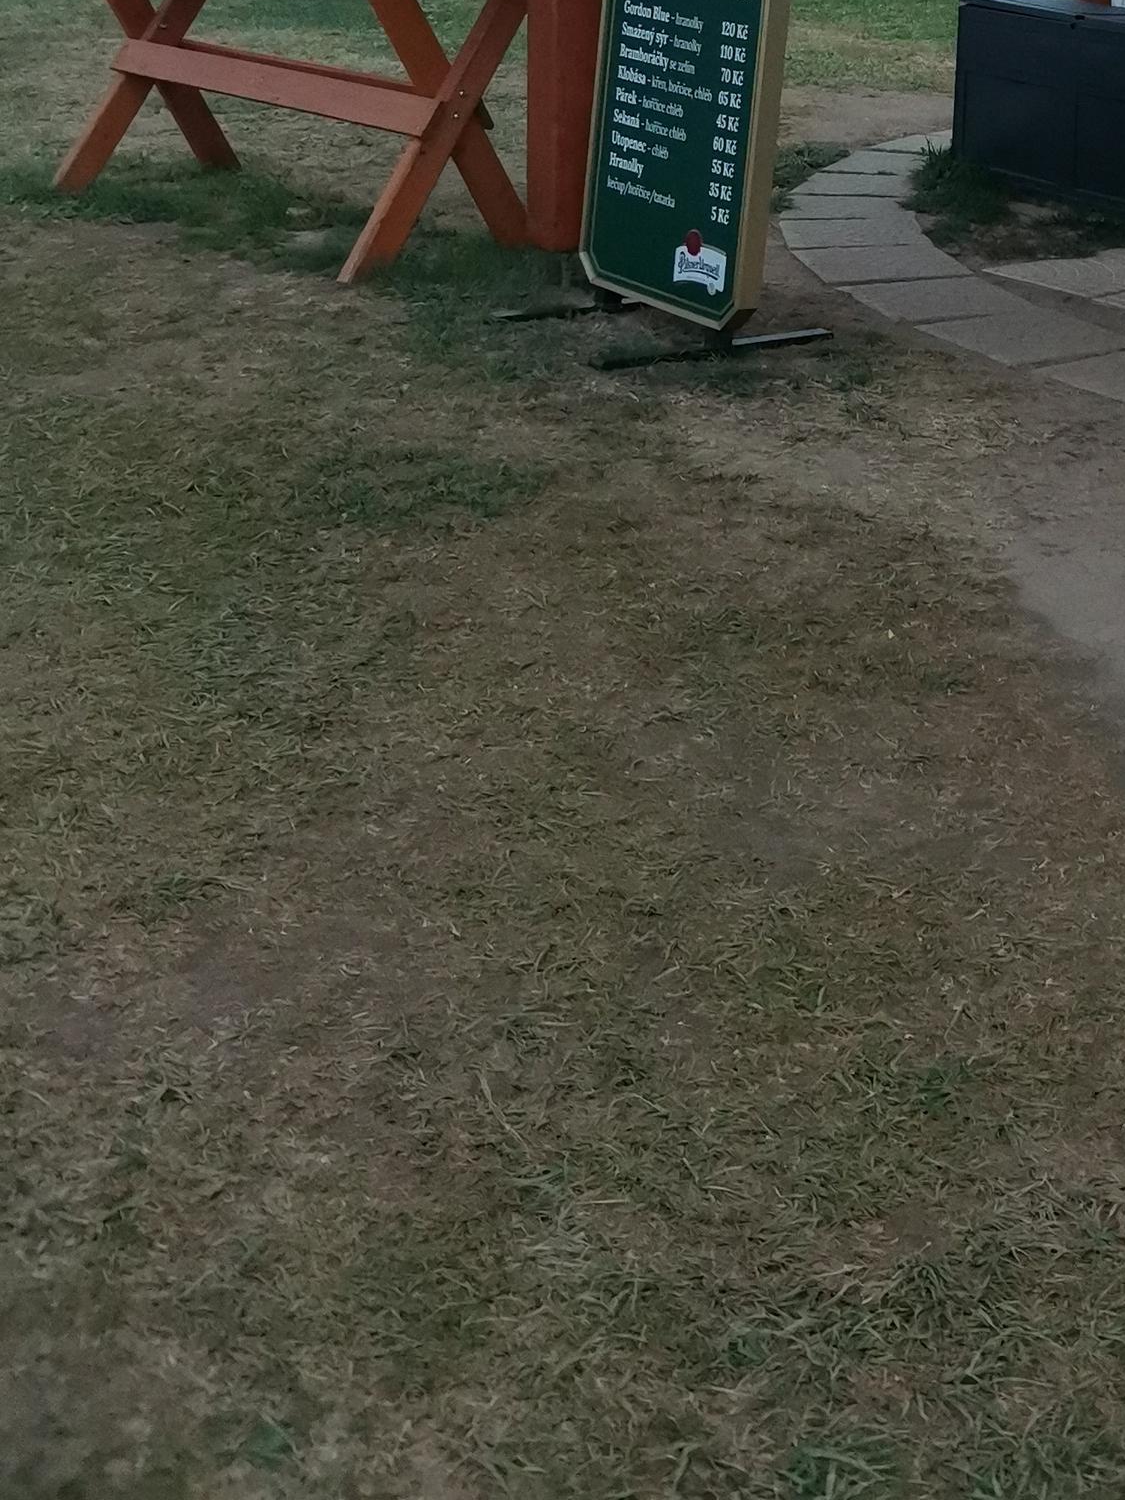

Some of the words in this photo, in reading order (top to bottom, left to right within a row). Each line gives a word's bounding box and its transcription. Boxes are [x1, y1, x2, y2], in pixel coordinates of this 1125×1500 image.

[621, 21, 655, 46] Smažený
[655, 29, 670, 49] sýr
[673, 35, 702, 56] hranolky
[719, 44, 734, 61] 110
[734, 46, 747, 64] Kč
[623, 0, 652, 19] Gordon
[652, 5, 670, 23] Blue
[675, 13, 704, 34] hranolky
[721, 21, 736, 38] 120
[736, 23, 749, 41] Kč
[617, 65, 647, 86] Klobása
[694, 86, 713, 103] chléb
[718, 90, 729, 107] 65
[729, 92, 742, 109] Kč
[619, 43, 669, 72] Bramboráčky
[669, 60, 677, 70] se
[720, 67, 732, 84] 70
[732, 70, 744, 87] Kč
[615, 86, 638, 105] Párek
[665, 102, 684, 118] chléb
[716, 113, 727, 130] 45
[727, 116, 740, 133] Kč
[613, 108, 640, 129] Sekaná
[668, 125, 687, 142] chléb
[712, 136, 724, 152] 60
[724, 139, 737, 156] Kč
[609, 151, 644, 179] Hranolky
[708, 182, 720, 198] 35
[720, 185, 732, 202] Kč
[611, 130, 647, 154] Utopenec
[651, 143, 669, 160] chléb
[711, 159, 722, 175] 55
[722, 162, 735, 179] Kč
[710, 206, 718, 222] 5
[717, 208, 730, 226] Kč
